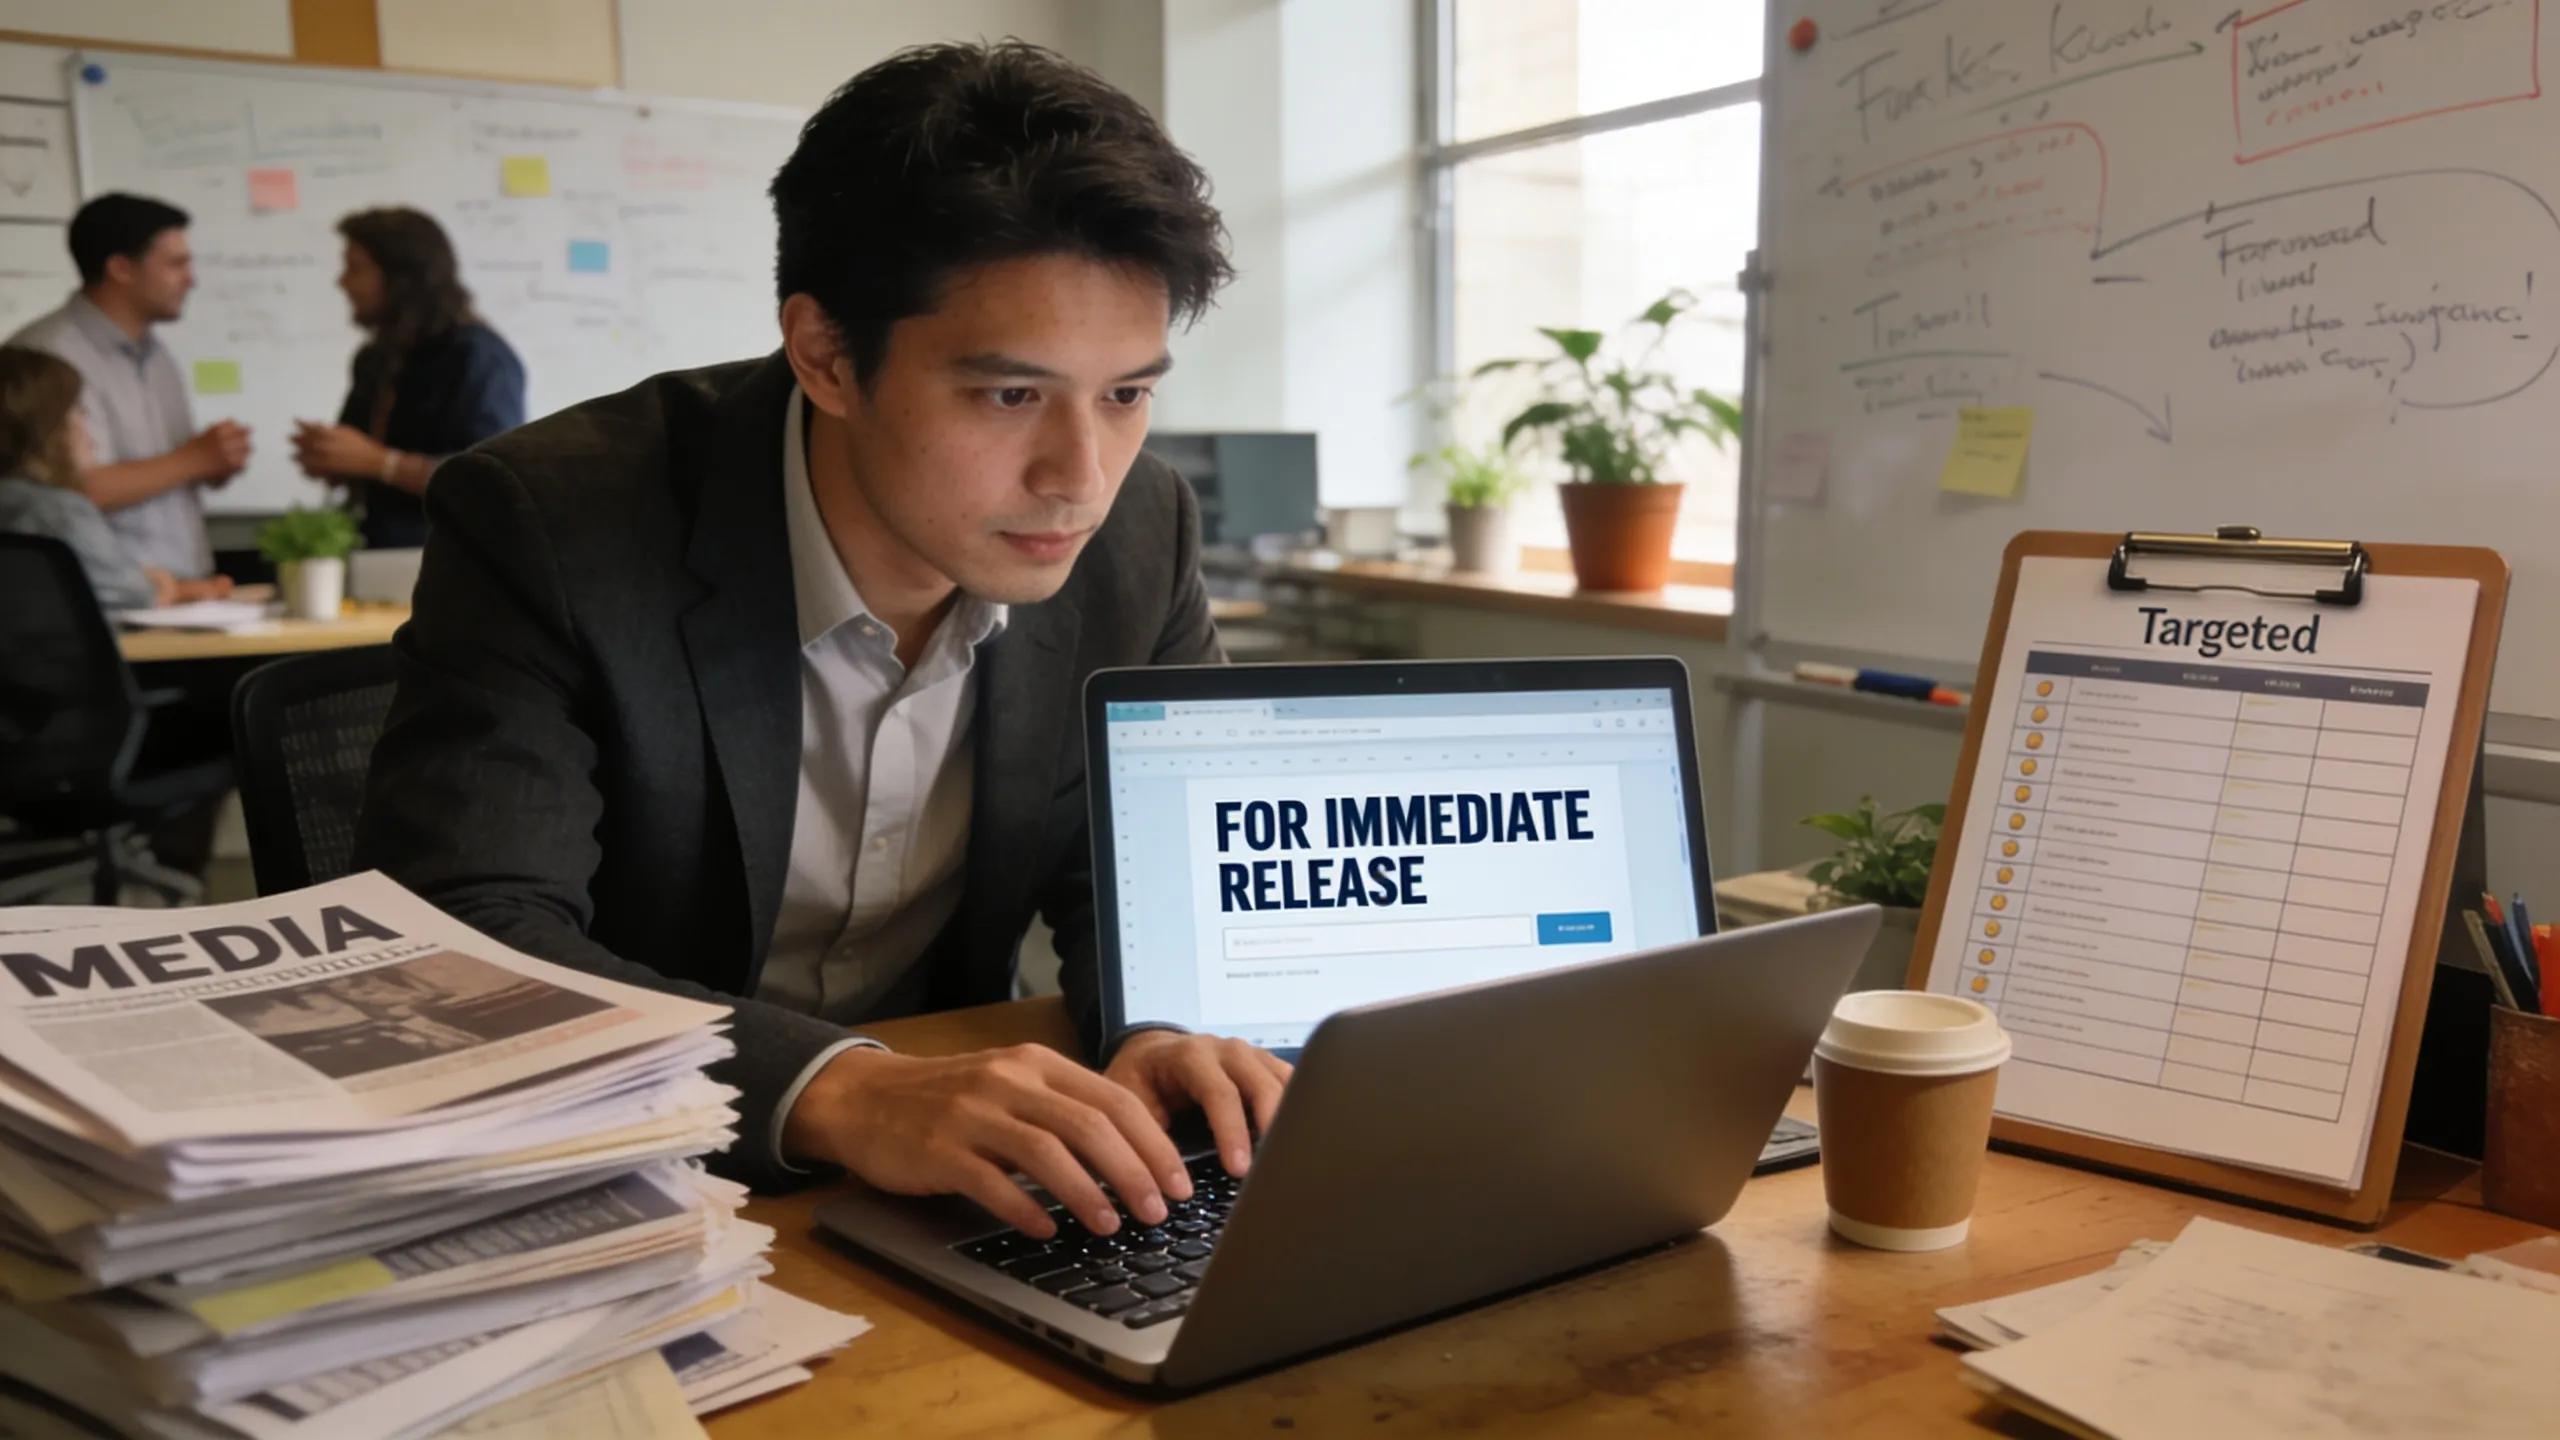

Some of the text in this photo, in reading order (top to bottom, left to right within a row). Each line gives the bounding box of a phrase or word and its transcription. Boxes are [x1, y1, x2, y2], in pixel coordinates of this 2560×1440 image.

[2138, 606, 2320, 658] Targeted
[1215, 789, 1594, 852] FOR IMMEDIATE
[1219, 855, 1428, 912] RELEASE
[0, 904, 405, 998] MEDIA
